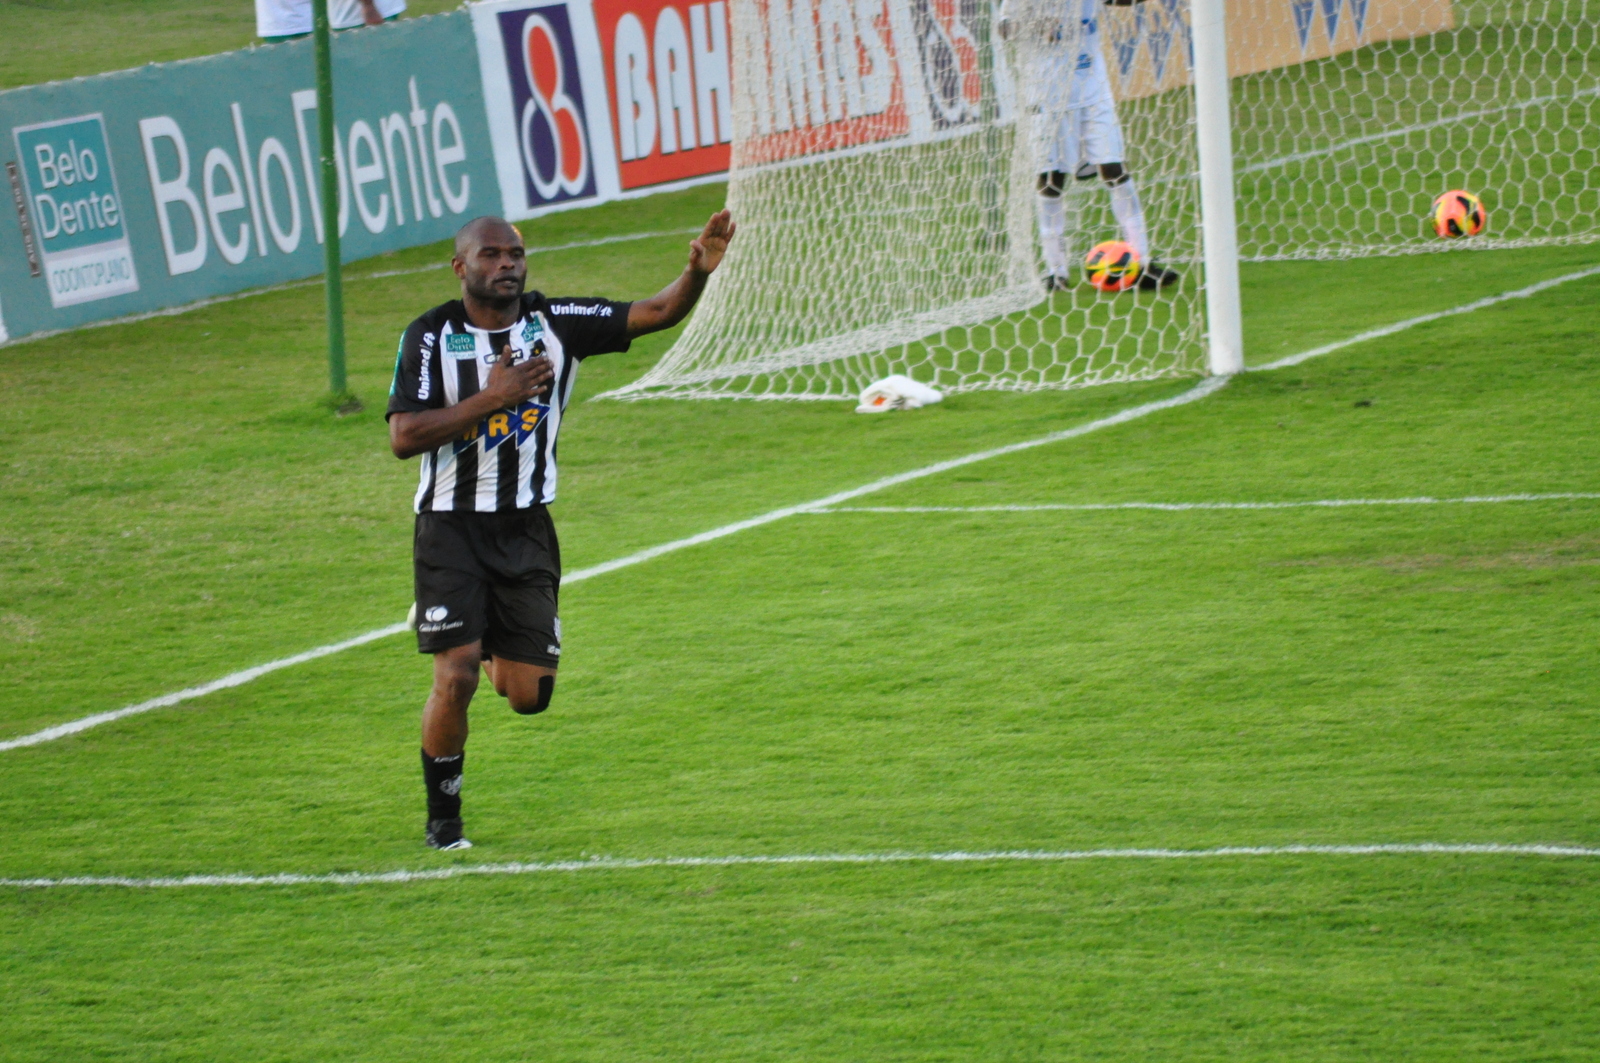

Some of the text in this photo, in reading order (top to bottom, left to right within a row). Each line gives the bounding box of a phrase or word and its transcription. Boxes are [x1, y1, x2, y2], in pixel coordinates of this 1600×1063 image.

[34, 139, 98, 190] Belo
[35, 191, 119, 239] Dente
[550, 302, 600, 316] Unimed
[417, 348, 432, 400] Unimed
